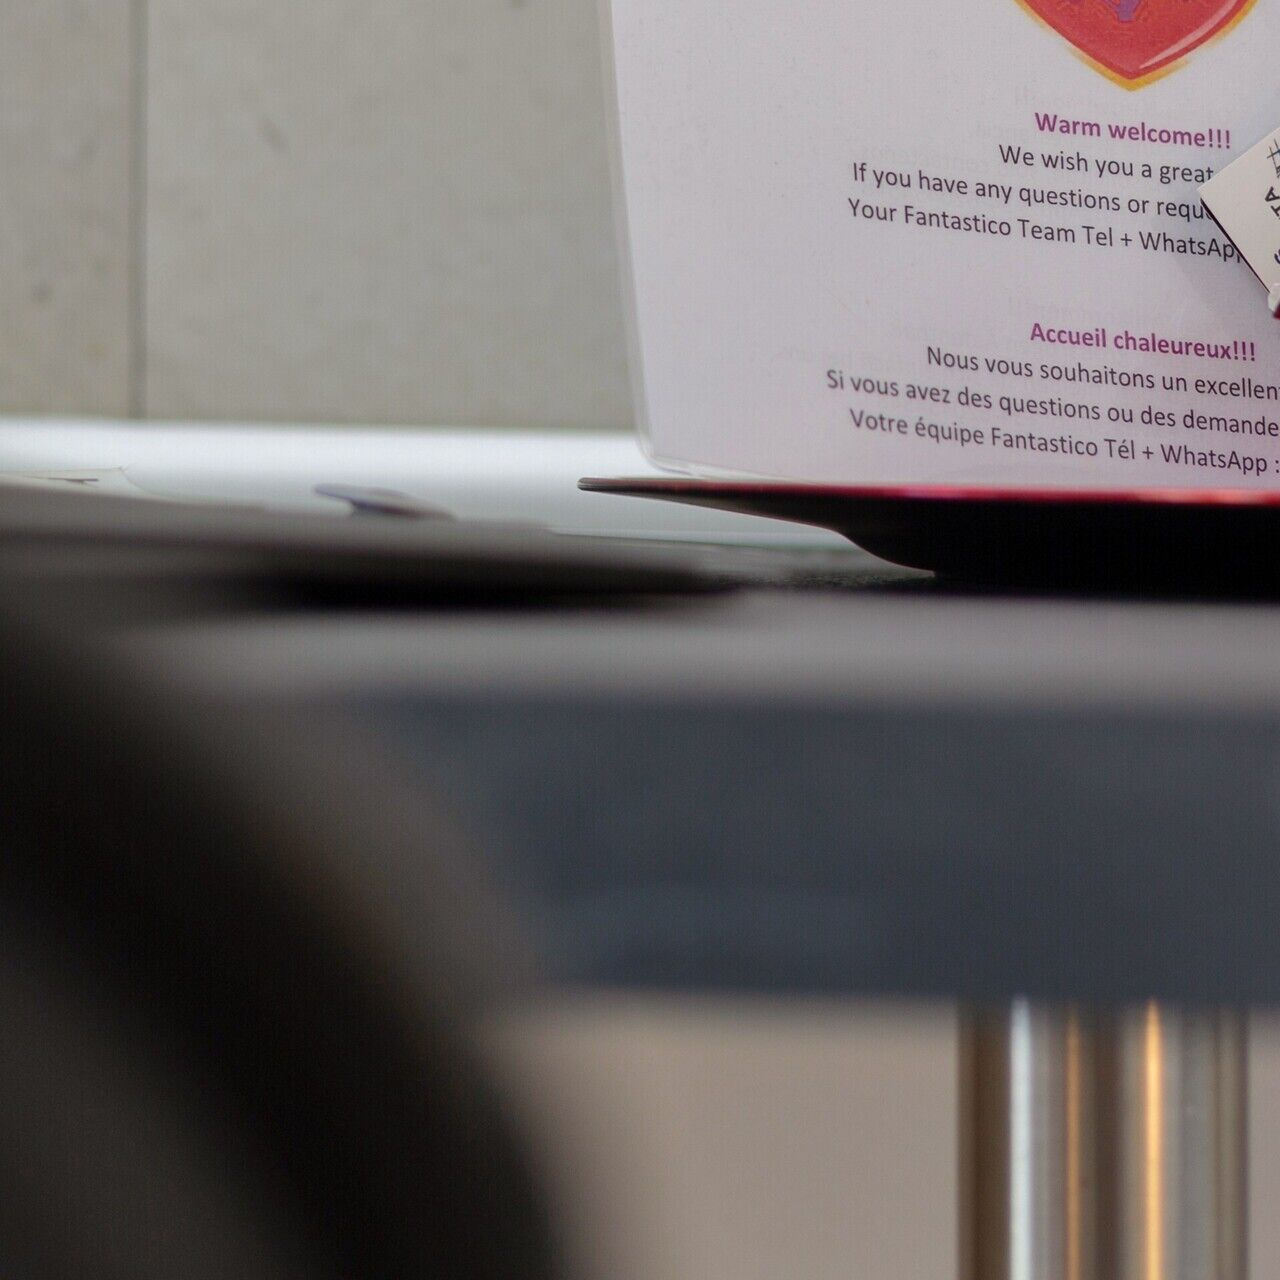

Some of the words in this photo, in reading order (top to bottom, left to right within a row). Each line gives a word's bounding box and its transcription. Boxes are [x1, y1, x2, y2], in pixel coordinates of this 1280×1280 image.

[1035, 113, 1101, 137] Warm
[1108, 122, 1230, 149] welcome!!!
[999, 144, 1034, 166] We
[1041, 151, 1088, 172] wish
[1095, 159, 1133, 178] you
[1141, 164, 1152, 178] a
[1160, 166, 1214, 184] great
[854, 162, 867, 182] If
[873, 170, 911, 189] you
[919, 170, 968, 195] have
[975, 183, 1012, 204] any
[1019, 188, 1120, 211] questions
[1128, 199, 1149, 214] or
[1157, 201, 1213, 223] requ
[848, 198, 897, 222] Your
[904, 205, 1011, 236] Fantastico
[1017, 219, 1075, 243] Team
[1082, 226, 1113, 247] Tel
[1120, 233, 1132, 246] +
[1030, 323, 1106, 348] Accueil
[1114, 330, 1255, 361] chaleureux!!!
[928, 346, 978, 371] Nous
[985, 358, 1033, 377] vous
[1040, 362, 1155, 389] souhaitons
[1162, 376, 1187, 392] un
[827, 370, 844, 389] Si
[851, 378, 899, 397] vous
[906, 384, 951, 403] avez
[958, 386, 992, 409] des
[999, 396, 1100, 420] questions
[1107, 407, 1133, 423] ou
[1141, 405, 1176, 427] des
[850, 409, 908, 434] Votre
[915, 417, 984, 446] équipe
[992, 427, 1098, 456] Fantastico
[1104, 439, 1135, 459] Tél
[1142, 446, 1154, 459] +
[1160, 444, 1267, 476] WhatsApp
